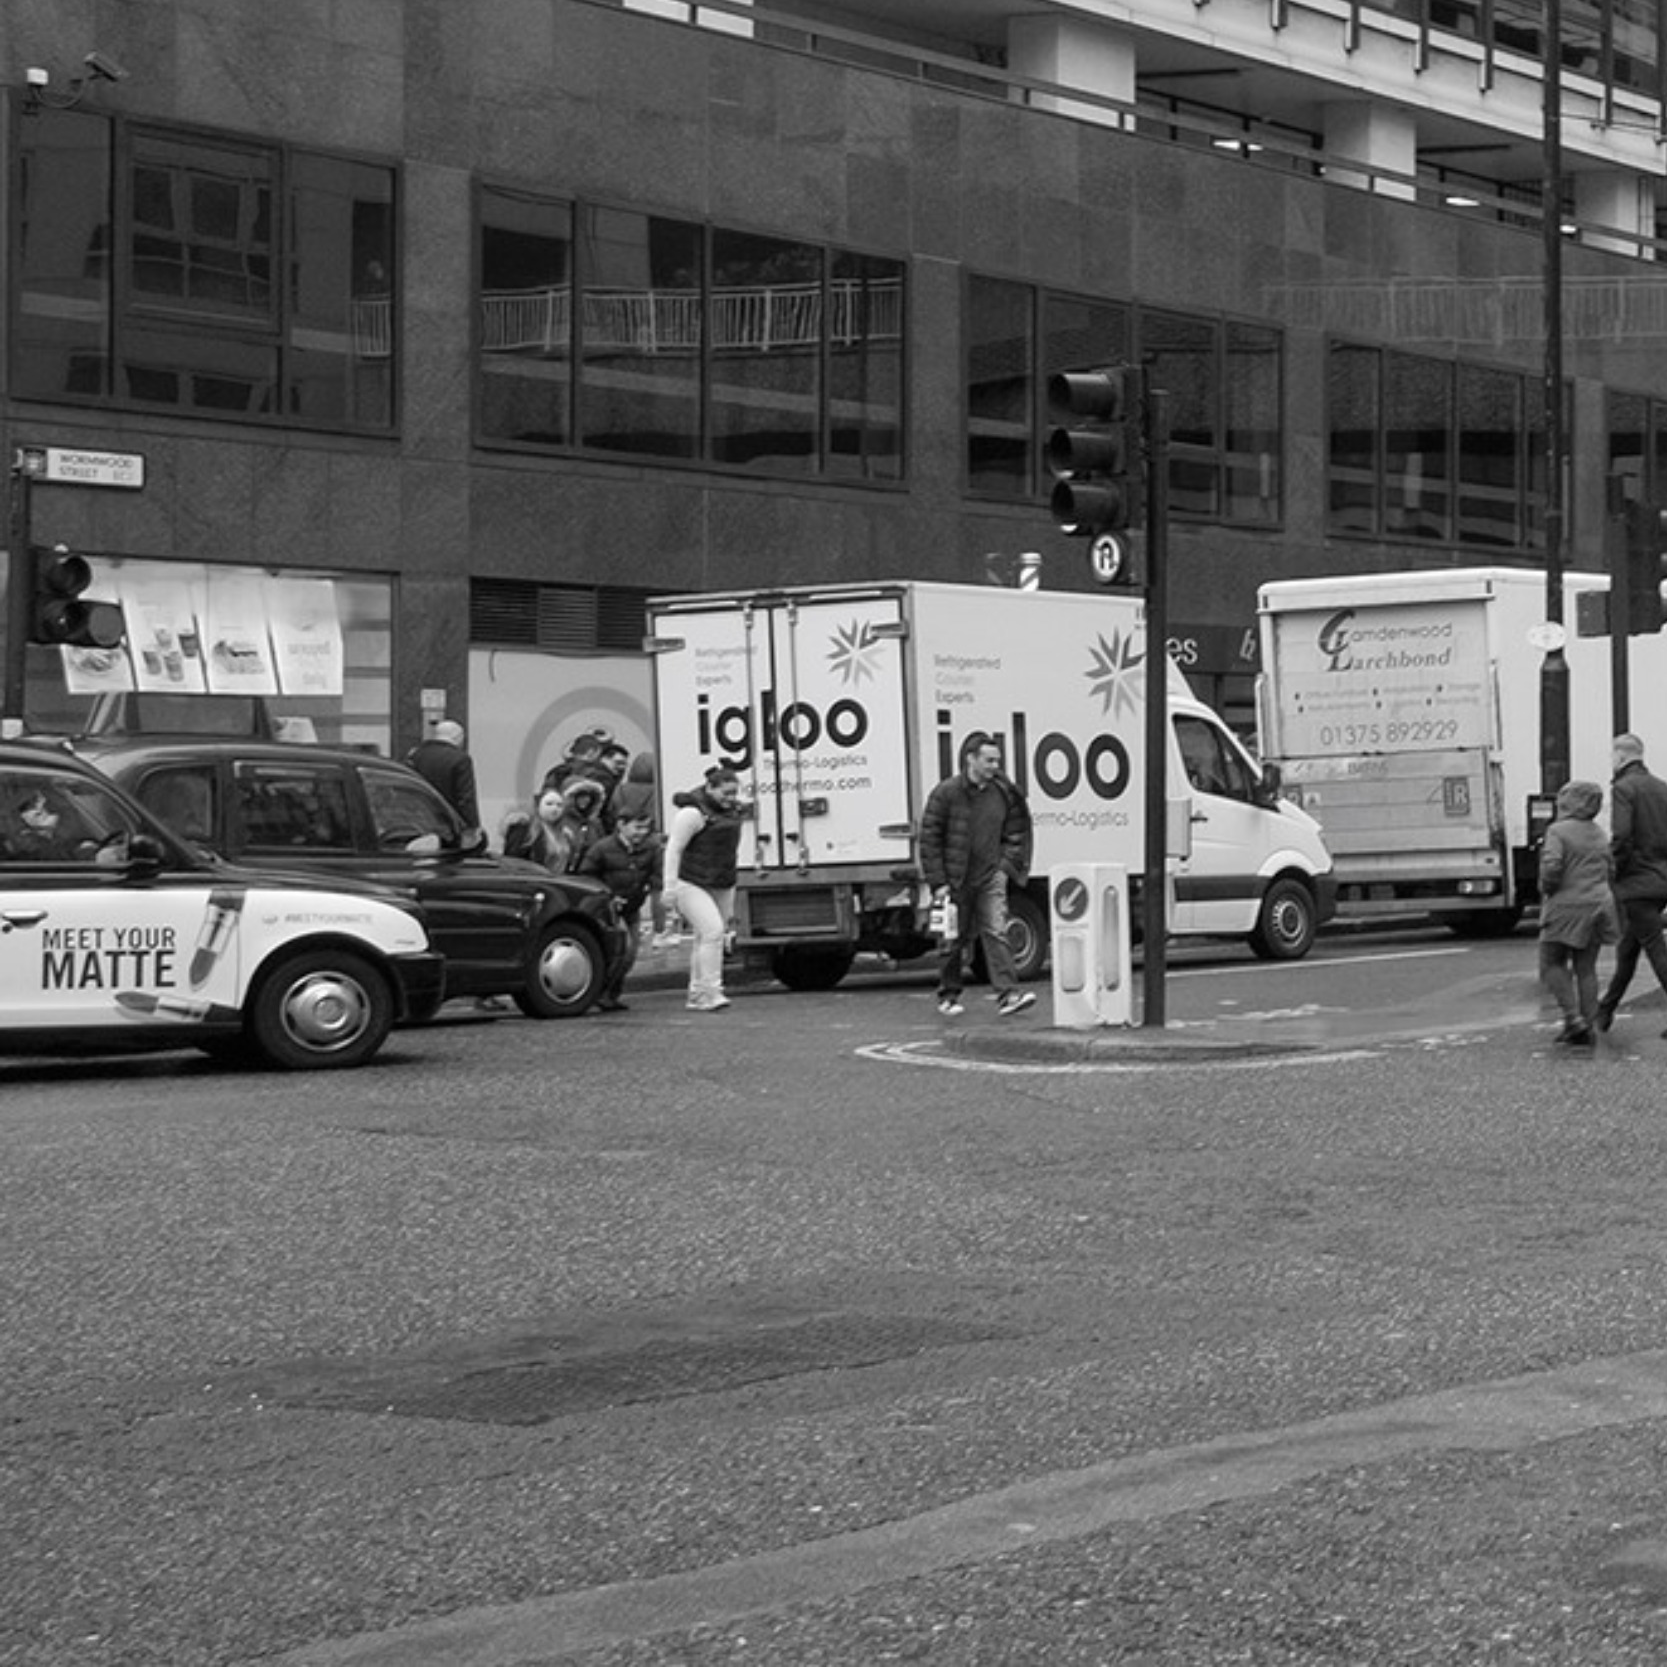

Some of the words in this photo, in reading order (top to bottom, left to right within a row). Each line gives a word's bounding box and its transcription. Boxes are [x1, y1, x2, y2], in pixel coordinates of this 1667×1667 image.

[697, 690, 869, 772] igloo
[763, 753, 867, 771] Thrmo-Logistics
[41, 928, 106, 951] MEET
[112, 926, 176, 950] YOUR
[41, 949, 176, 990] MATTE
